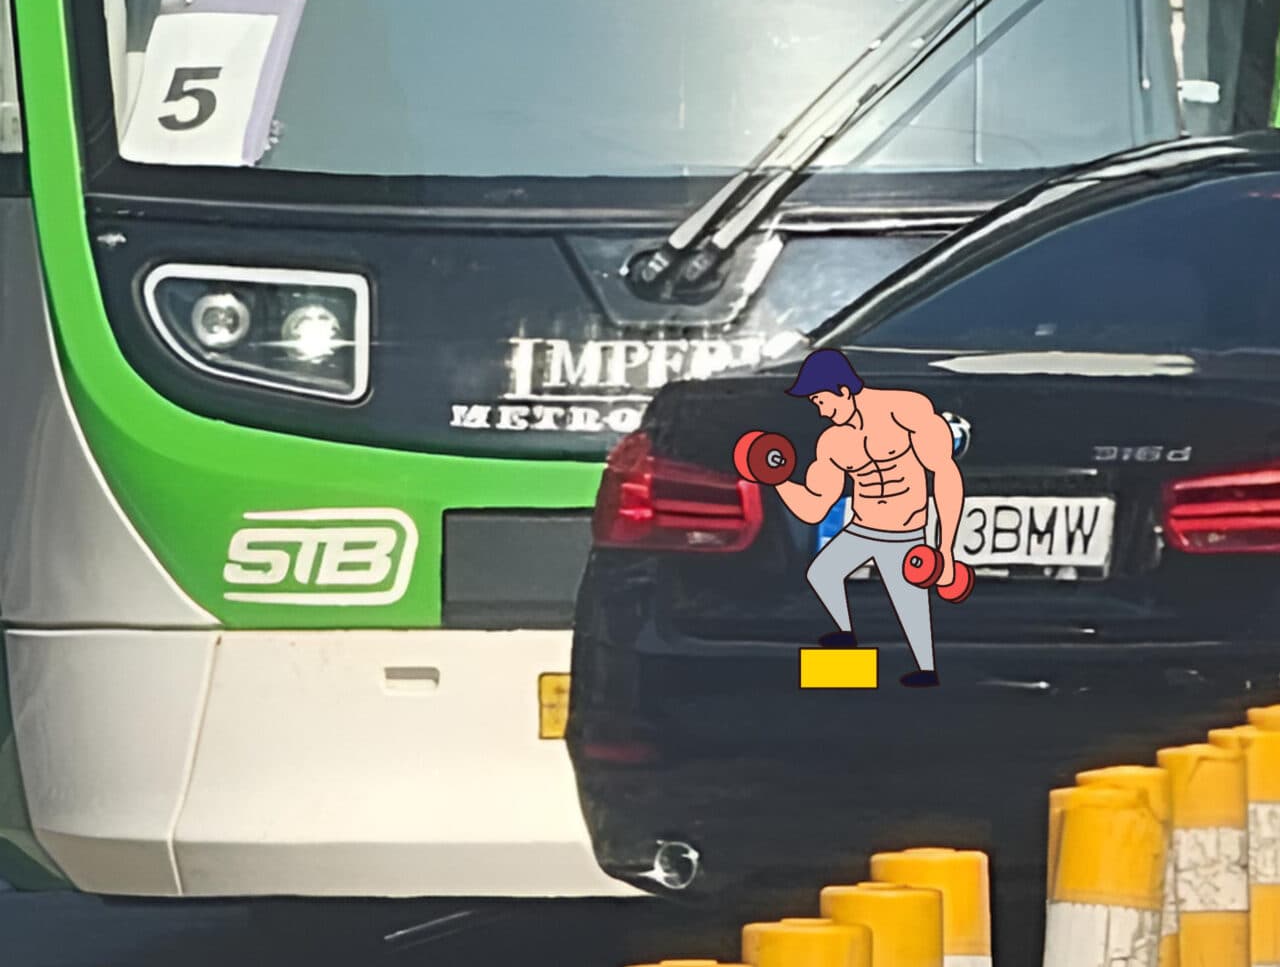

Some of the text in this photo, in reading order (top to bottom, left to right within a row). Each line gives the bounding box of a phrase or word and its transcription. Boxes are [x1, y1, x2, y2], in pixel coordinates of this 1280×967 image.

[158, 66, 222, 131] 5
[450, 404, 649, 433] METRO
[224, 528, 397, 585] STB
[934, 504, 1100, 556] 3BMW
